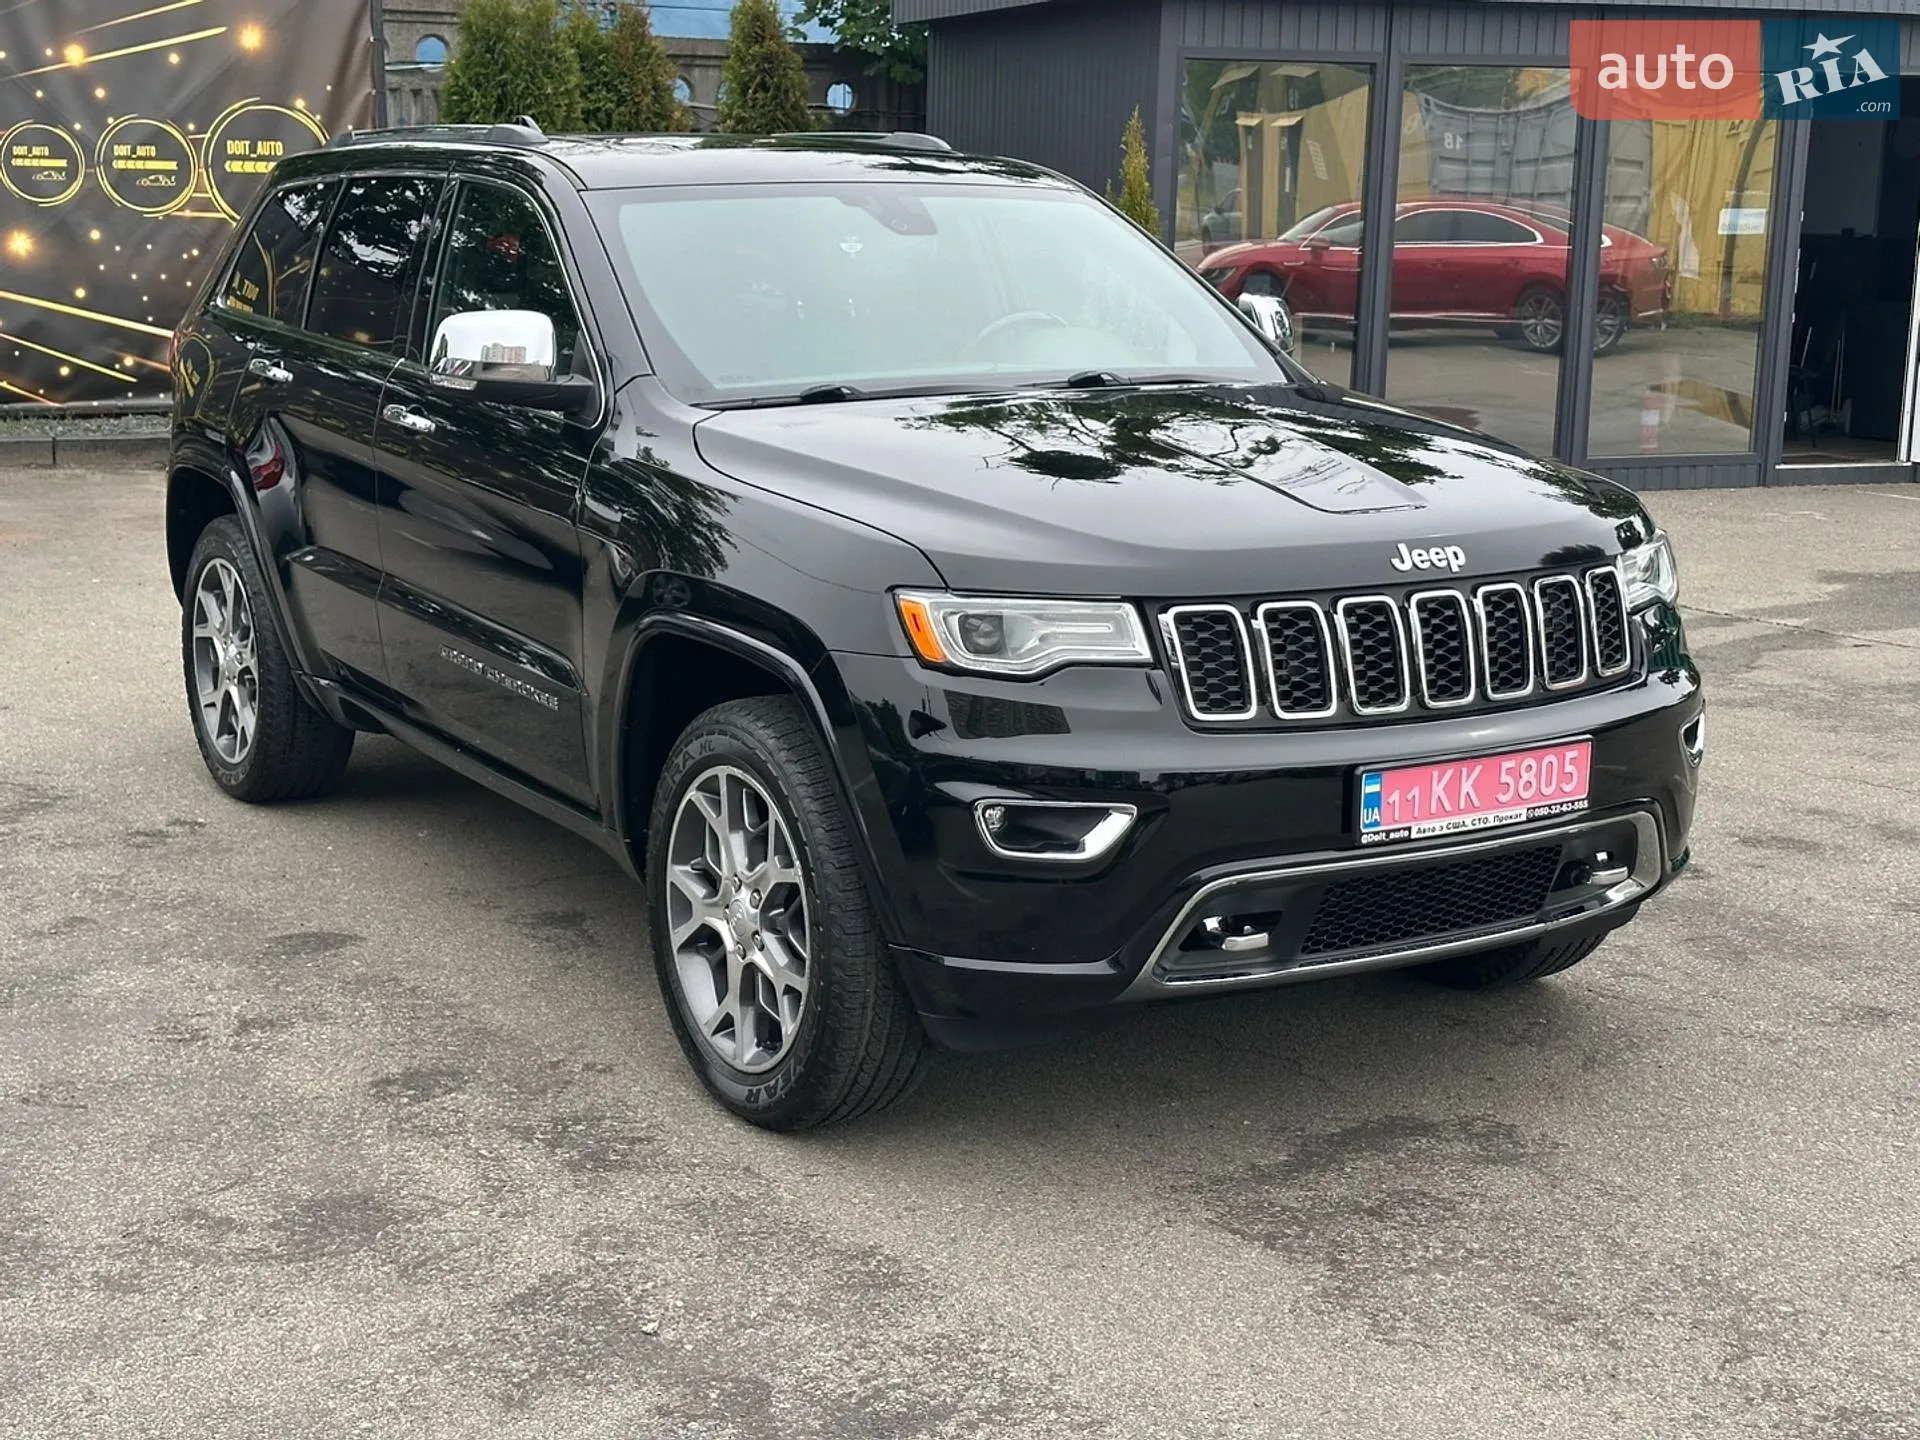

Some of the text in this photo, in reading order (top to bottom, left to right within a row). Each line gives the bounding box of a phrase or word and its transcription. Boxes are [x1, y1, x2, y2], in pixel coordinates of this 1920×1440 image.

[112, 144, 157, 158] DOIT_AUTO
[226, 139, 284, 158] DOIT_AUTO
[1390, 542, 1466, 573] Jeep
[1494, 750, 1580, 804] 5805
[1363, 808, 1381, 825] UA
